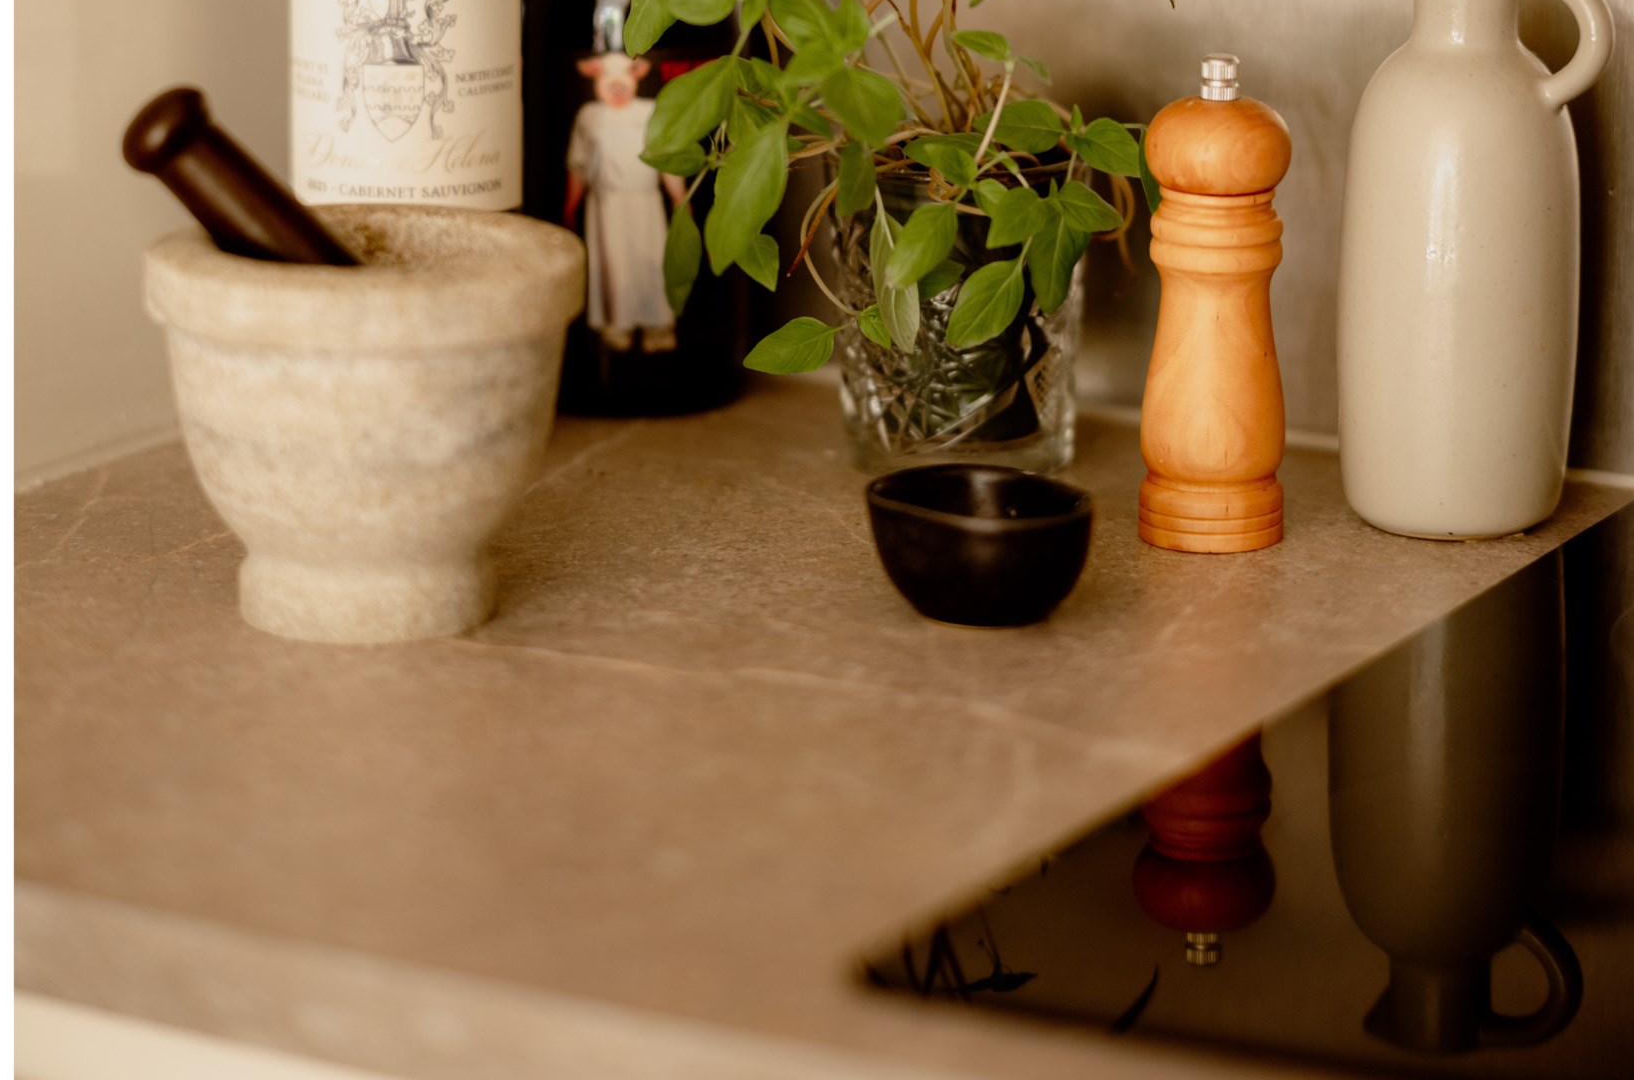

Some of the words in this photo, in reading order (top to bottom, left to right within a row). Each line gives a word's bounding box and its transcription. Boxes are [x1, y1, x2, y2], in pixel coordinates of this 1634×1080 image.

[455, 69, 491, 84] NORTH
[338, 183, 417, 199] CABERNET
[421, 177, 503, 199] SAUVIGNON
